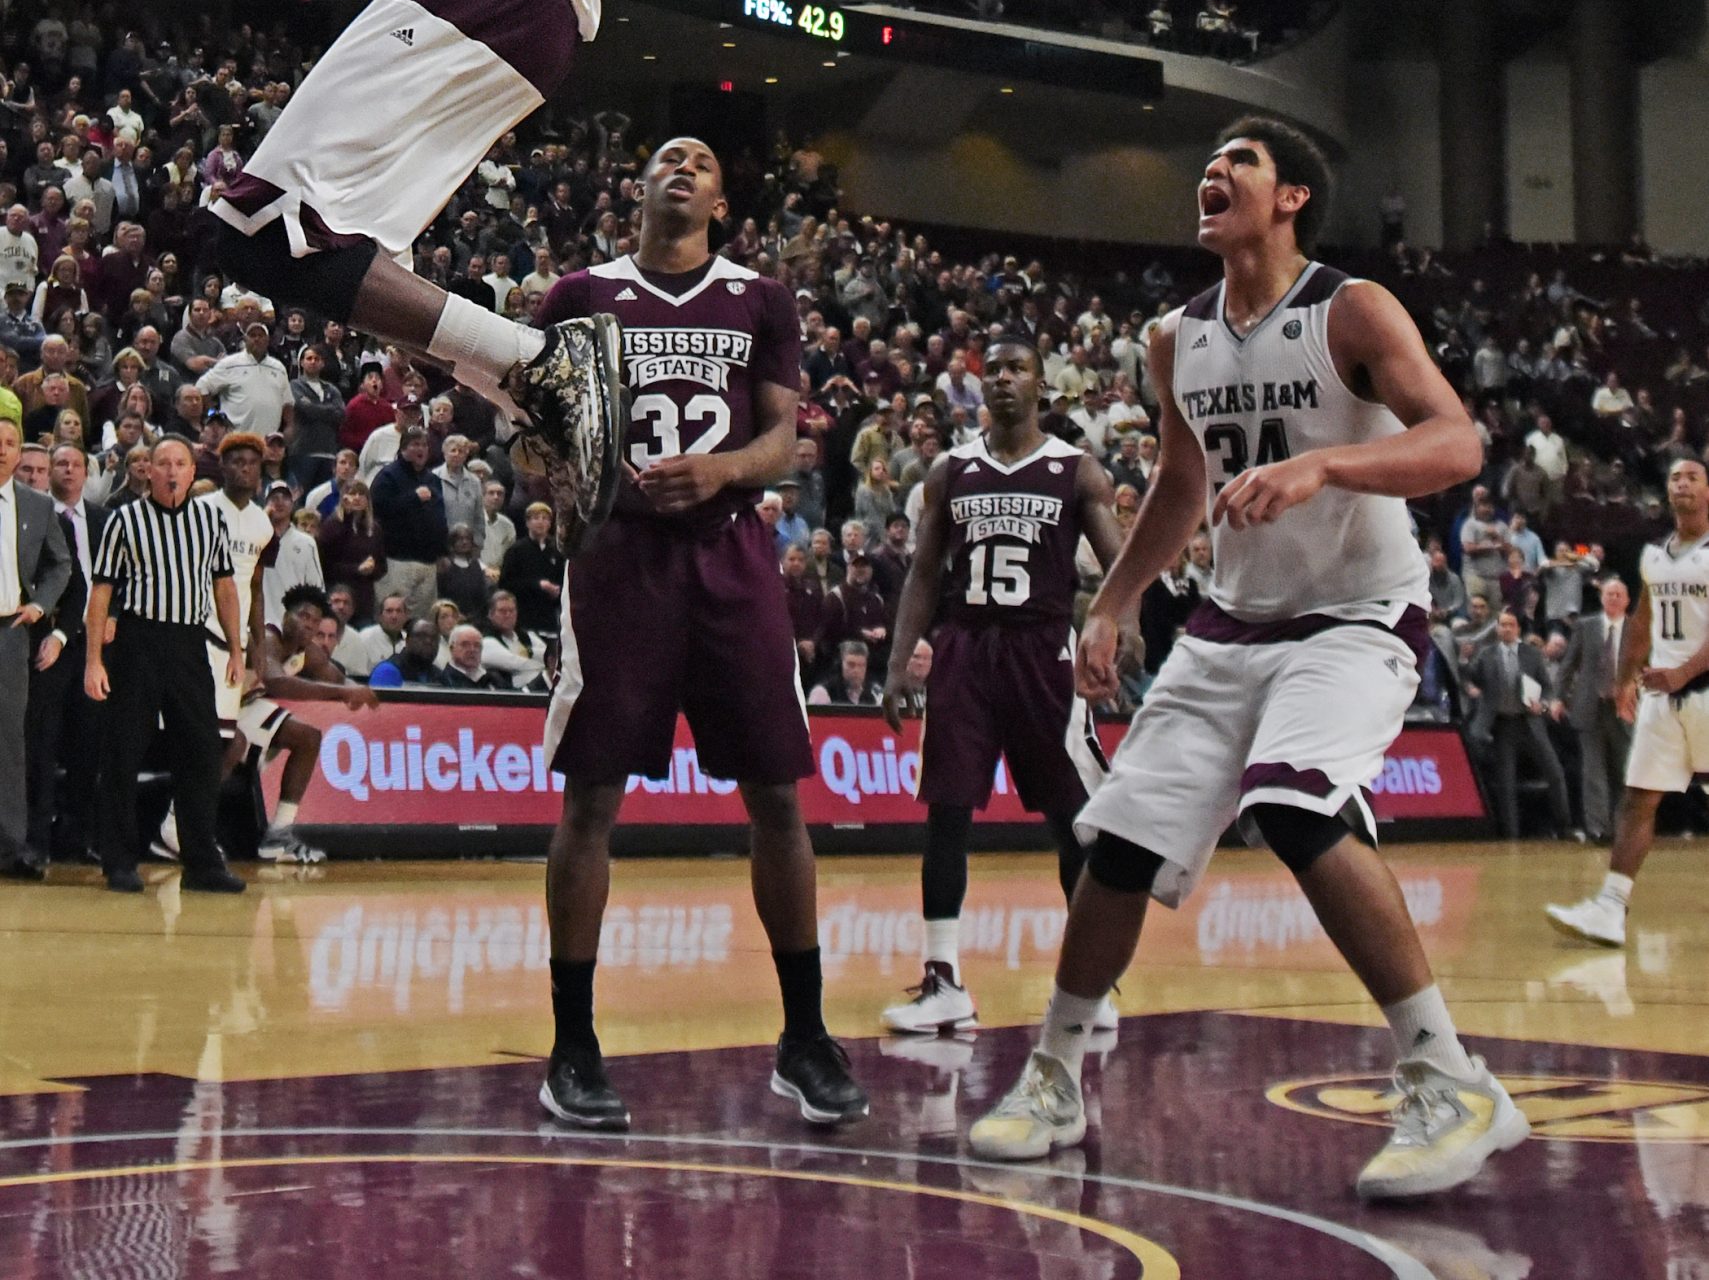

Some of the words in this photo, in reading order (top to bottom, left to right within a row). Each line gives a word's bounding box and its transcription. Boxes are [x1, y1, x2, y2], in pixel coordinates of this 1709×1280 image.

[797, 4, 845, 42] 42.9
[624, 332, 752, 362] ISSISSIPPI
[646, 358, 714, 383] STATE
[1182, 382, 1257, 420] TEXAS
[1262, 379, 1319, 412] A&M
[631, 394, 731, 471] 32
[951, 497, 1063, 521] MISSISSIPPI
[978, 520, 1028, 537] STATE
[966, 545, 1031, 607] 15
[1660, 600, 1686, 640] 11
[1370, 755, 1442, 795] ans
